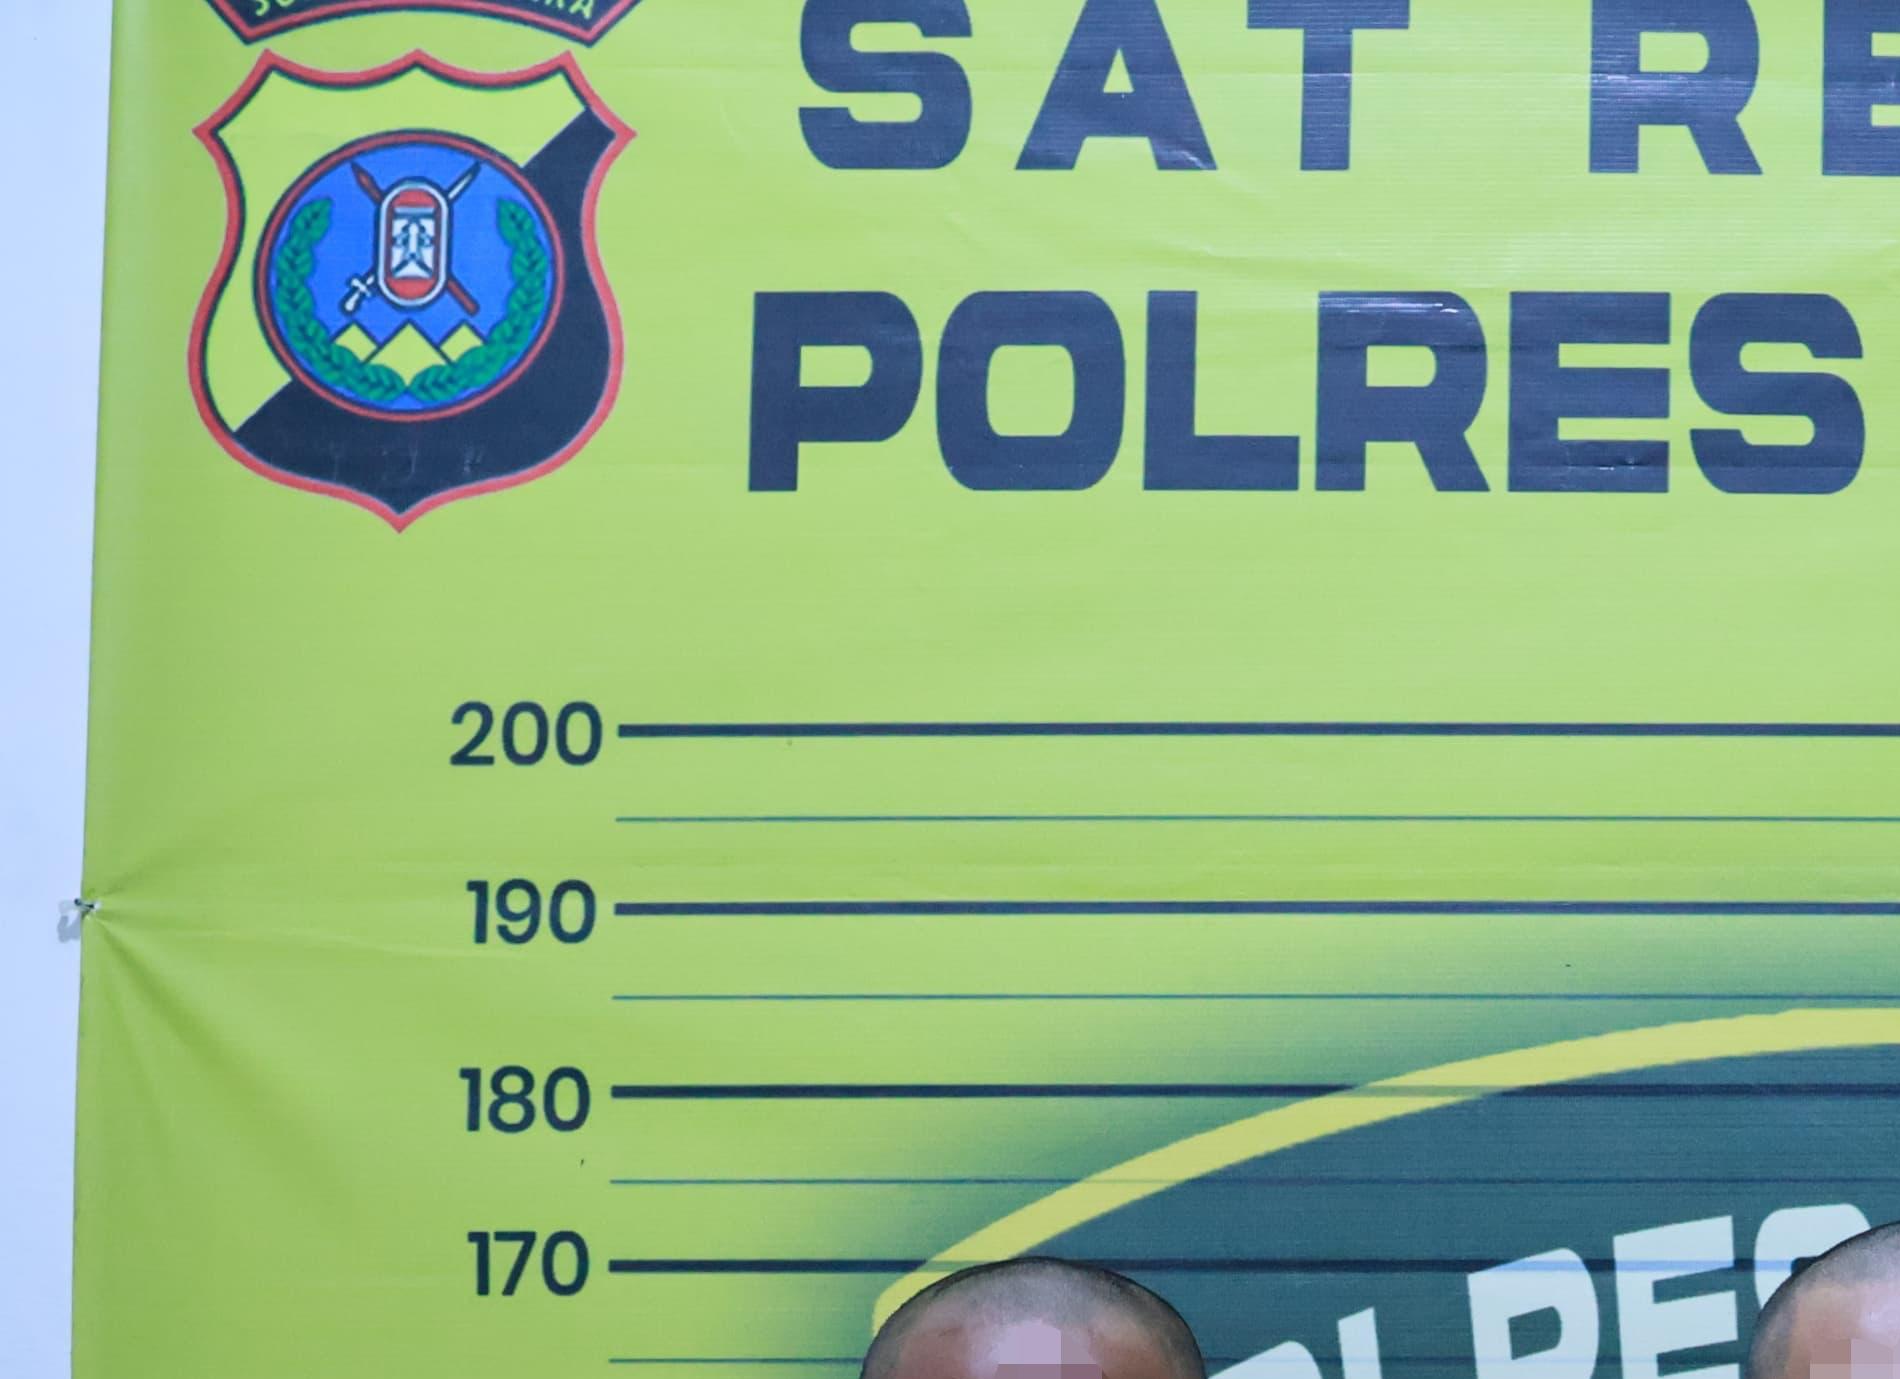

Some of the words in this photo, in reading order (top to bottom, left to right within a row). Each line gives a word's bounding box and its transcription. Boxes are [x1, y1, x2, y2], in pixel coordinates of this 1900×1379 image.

[798, 0, 1410, 171] SAT
[748, 290, 1865, 494] POLRES
[450, 702, 602, 765] 200
[466, 878, 596, 944] 190
[459, 1065, 591, 1133] 180
[467, 1230, 590, 1296] 170
